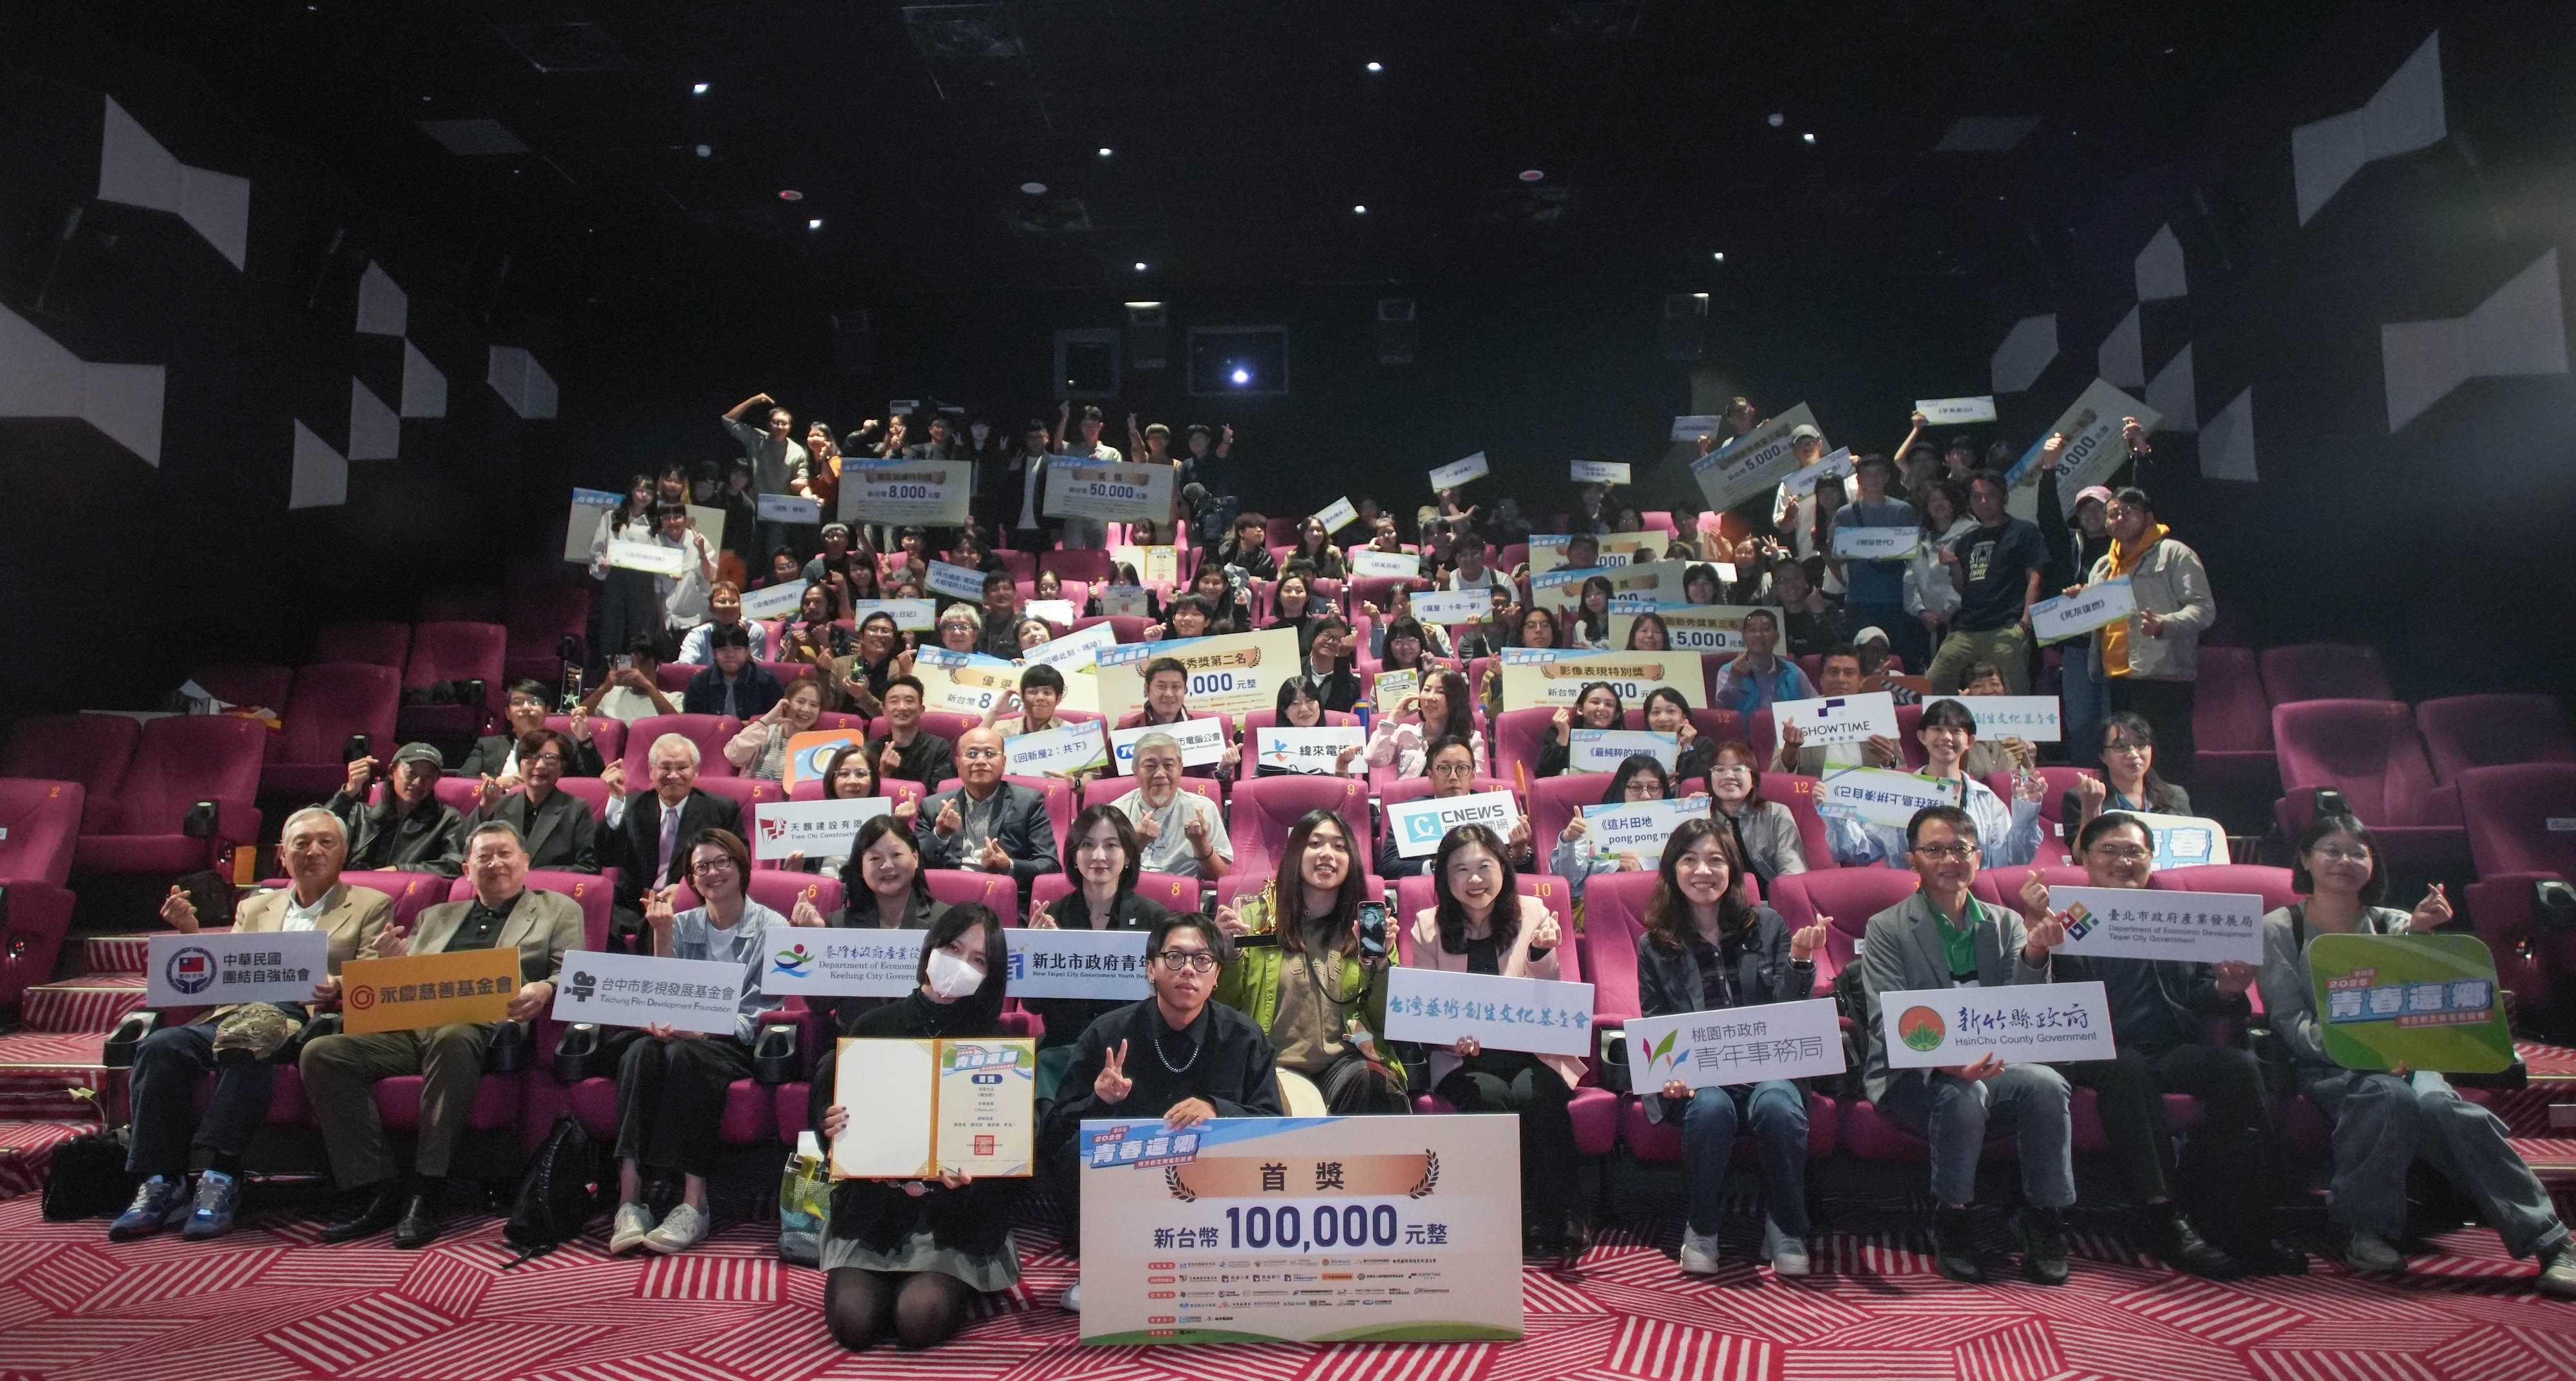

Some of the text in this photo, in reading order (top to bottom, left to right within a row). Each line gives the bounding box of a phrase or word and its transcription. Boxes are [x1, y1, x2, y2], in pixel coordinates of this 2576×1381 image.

[889, 485, 926, 500] 8,000
[1090, 483, 1133, 499] 50,000
[1677, 631, 1727, 647] 5,000
[1560, 665, 1645, 677] 影像表現特別獎
[982, 674, 1013, 689] 優選
[1236, 678, 1256, 689] 元整
[947, 692, 976, 706] 新台幣
[1548, 688, 1577, 697] 新台幣
[600, 721, 608, 732] 3
[838, 718, 846, 728] 5
[961, 718, 969, 727] 6
[1342, 718, 1349, 727] 9
[1801, 721, 1870, 736] SHOWTIME
[1012, 740, 1087, 764] 《回新屋2：共下》
[50, 787, 60, 797] 2
[472, 785, 480, 796] 3
[753, 785, 761, 797] 5
[899, 786, 907, 796] 6
[1046, 785, 1055, 796] 7
[1197, 784, 1206, 795] 8
[1347, 784, 1355, 795] 9
[1794, 781, 1809, 794] 12
[1442, 804, 1504, 823] CNEWS
[1601, 816, 1653, 830] 《這片田地
[1609, 835, 1633, 844] pong
[1634, 833, 1658, 843] pong
[408, 881, 417, 893] 4
[574, 883, 584, 897] 5
[808, 884, 817, 898] 6
[985, 881, 995, 895] 7
[1171, 882, 1180, 896] 8
[1533, 882, 1551, 897] 10
[2108, 908, 2253, 928] 臺北市政府產業發展局
[2108, 925, 2152, 933] Department
[2163, 927, 2201, 935] Economic
[2202, 928, 2253, 938] Development
[2108, 933, 2130, 942] Taipei
[2132, 934, 2147, 943] City
[223, 951, 281, 967] 中華民國
[819, 960, 867, 970] Department
[222, 967, 310, 985] 團結自強協會
[830, 971, 916, 981] Keelung City Govern
[380, 976, 513, 1004] 永慶慈善基金會
[601, 978, 735, 1001] 台中市影視發展基金會
[2328, 979, 2368, 989] 2025
[600, 994, 732, 1013] Taichung Film Development Foundation
[2330, 981, 2487, 1018] 青春還鄉
[1389, 995, 1590, 1030] 台灣藝術創生文化基金會
[1957, 1003, 2088, 1034] 新竹縣政府
[1691, 1021, 1768, 1043] 桃園市政府
[1955, 1032, 2097, 1047] HsinChu County Government
[1694, 1036, 1823, 1072] 青年事務局
[1092, 1134, 1197, 1164] 青春還鄉
[1259, 1161, 1345, 1192] 首獎
[1153, 1204, 1448, 1254] 新台幣 100,000 元整
